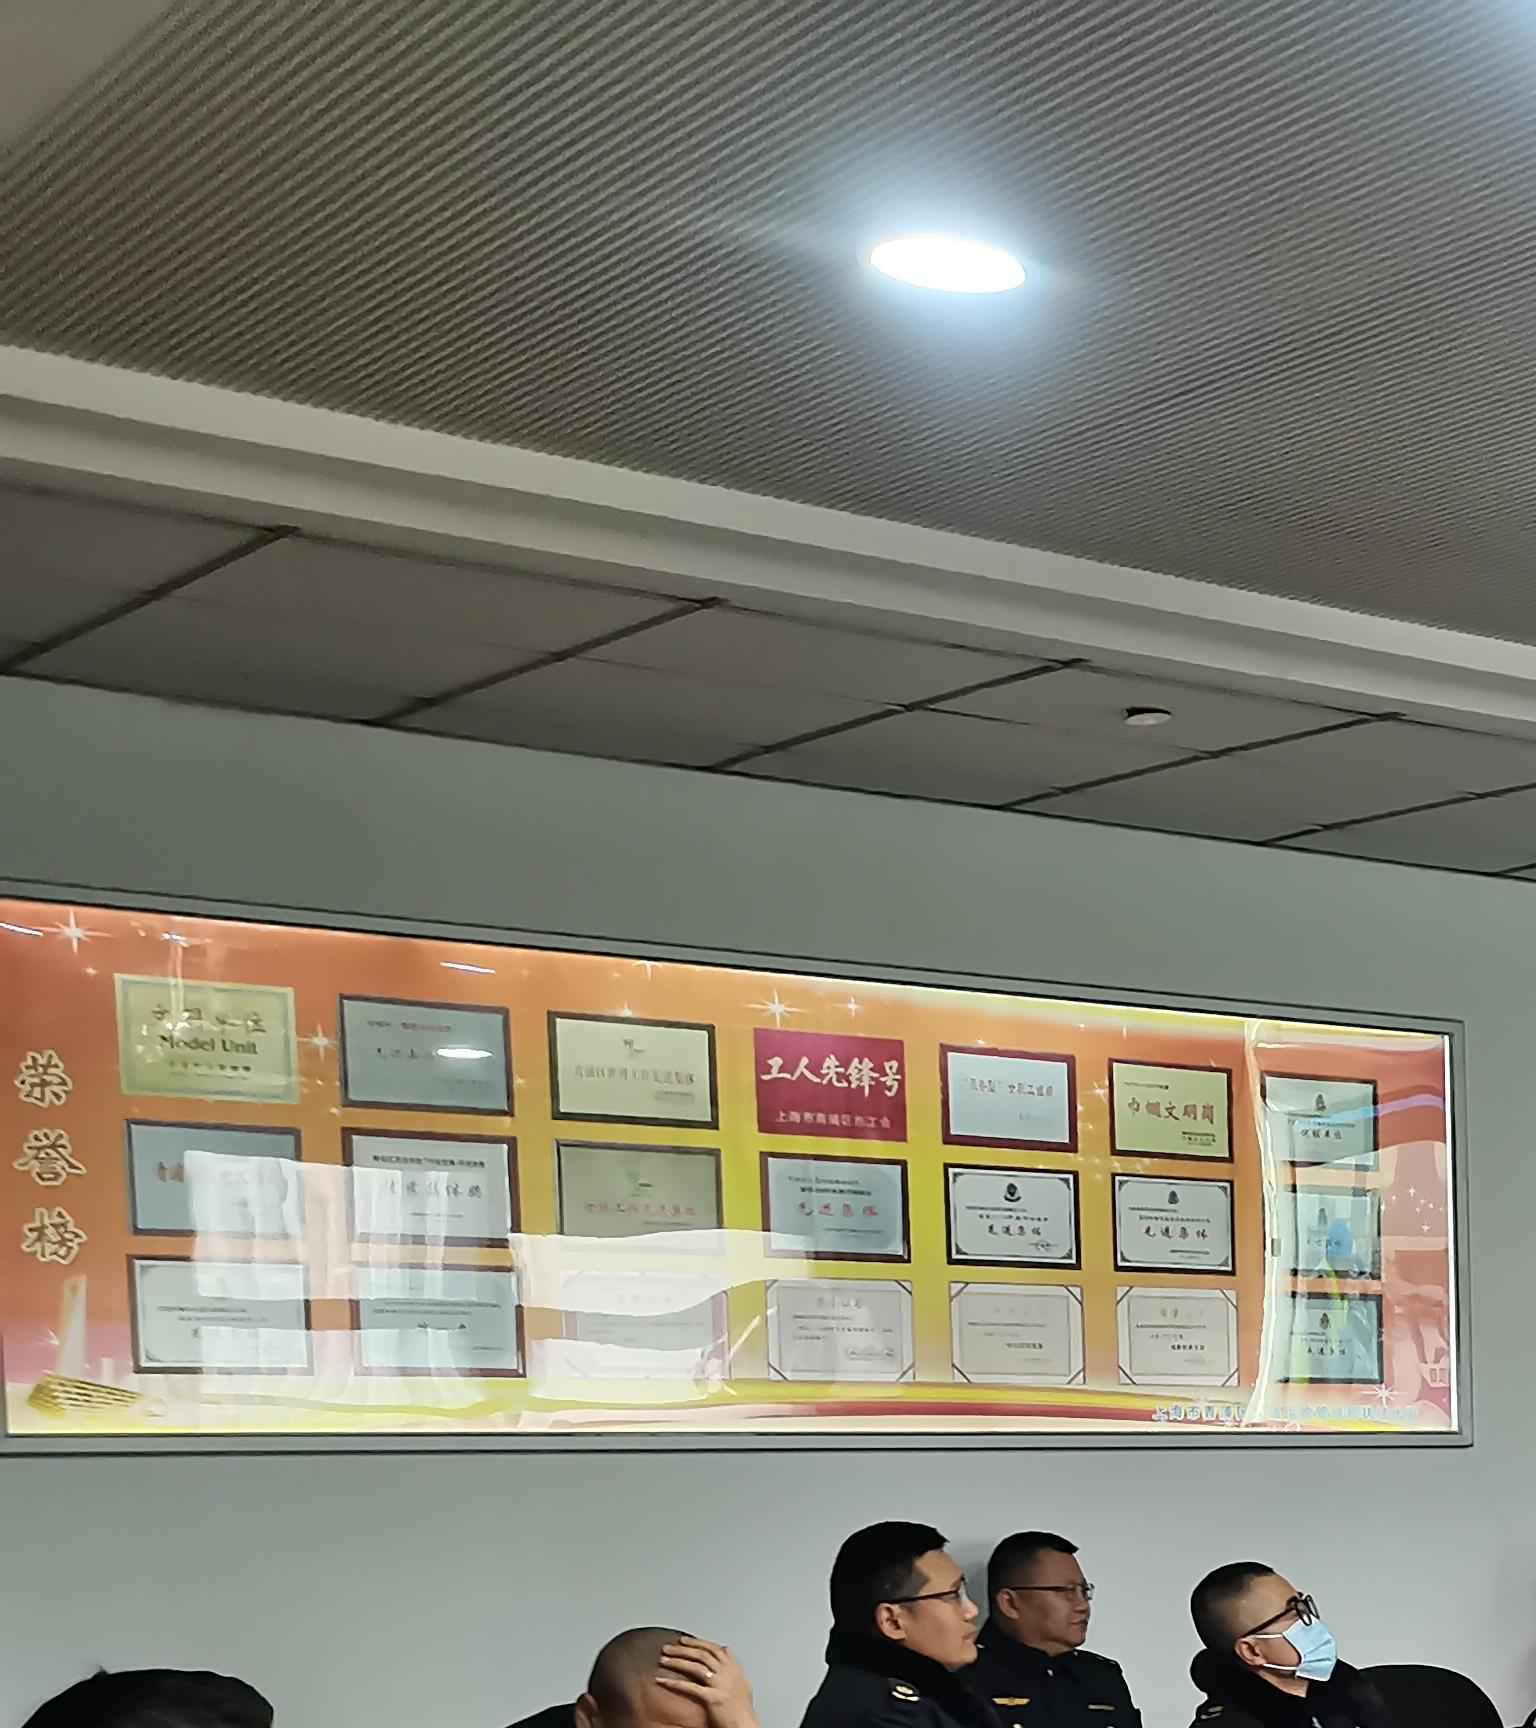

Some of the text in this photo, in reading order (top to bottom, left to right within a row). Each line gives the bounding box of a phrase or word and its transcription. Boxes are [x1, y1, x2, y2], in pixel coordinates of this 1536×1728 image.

[158, 1033, 258, 1055] Model Unit
[760, 1053, 902, 1098] 工人先锋号
[13, 1049, 88, 1265] 荣誉榜
